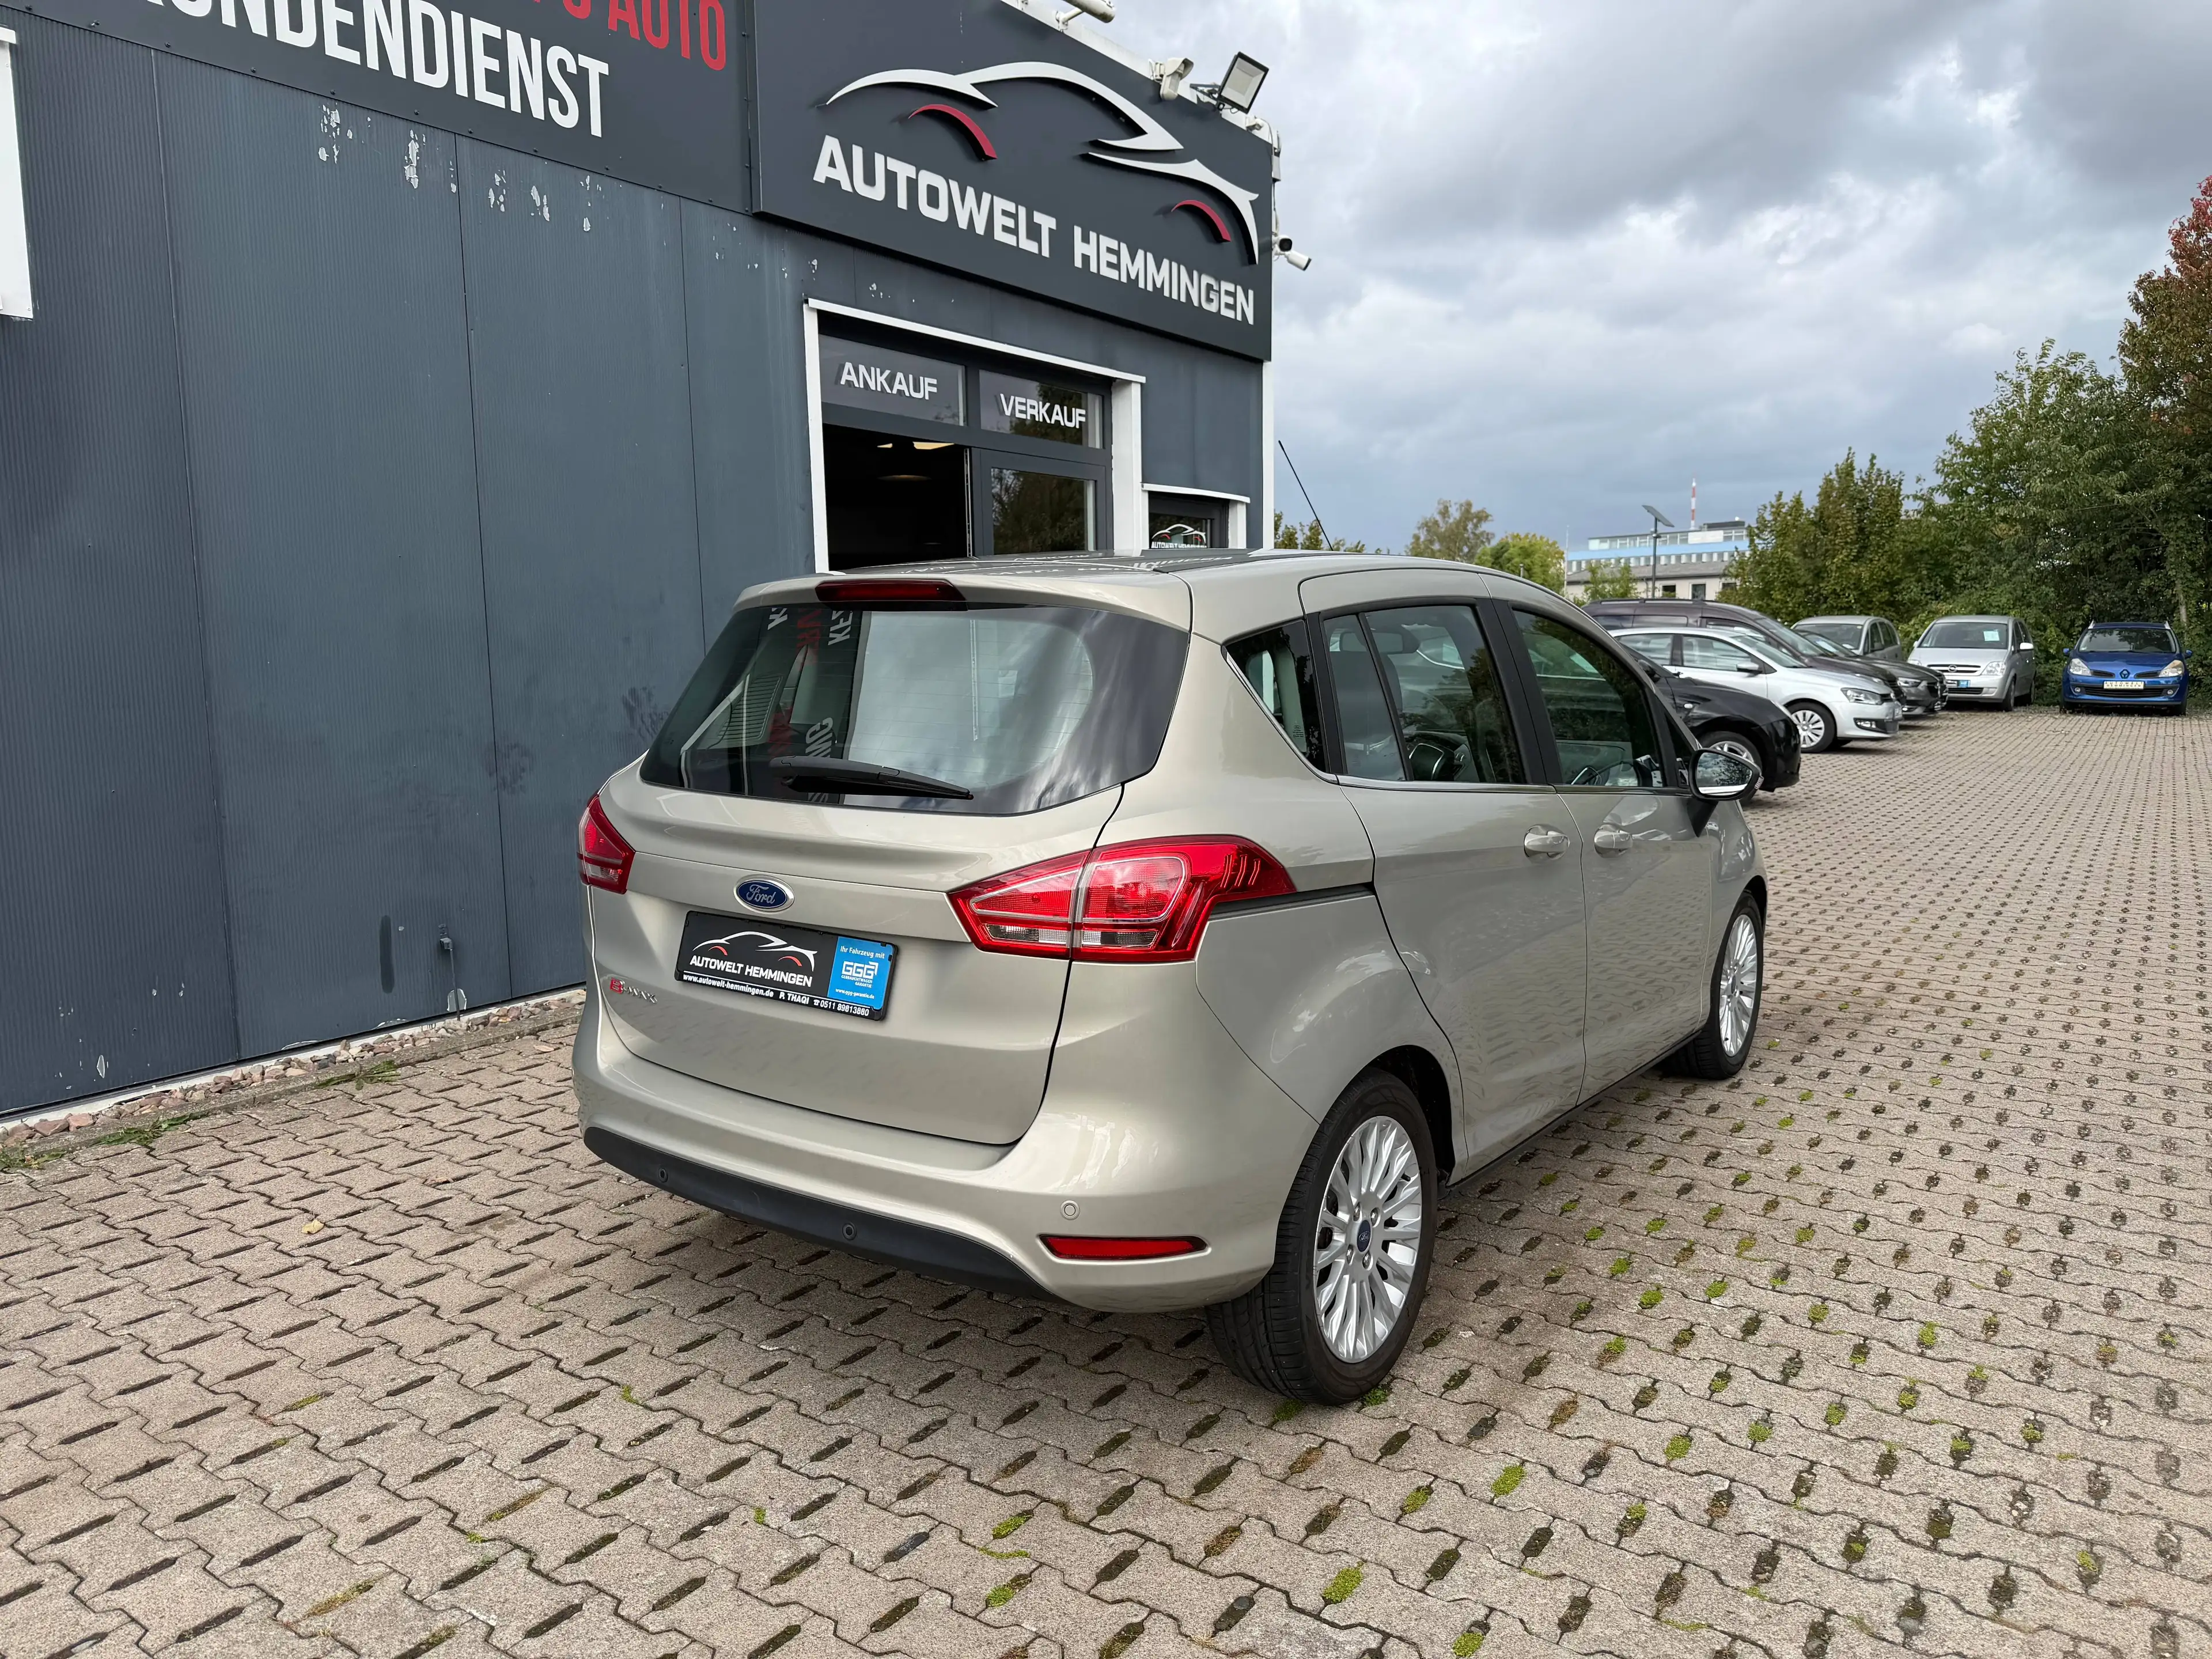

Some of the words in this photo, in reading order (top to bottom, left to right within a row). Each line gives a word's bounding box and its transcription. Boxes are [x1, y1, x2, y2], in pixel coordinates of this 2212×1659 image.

[146, 0, 609, 138] DENDIENST
[813, 134, 1056, 259] AUTOWELT
[1073, 225, 1255, 325] HEMMINGEN
[840, 362, 938, 400] ANKAUF
[999, 393, 1086, 429] VERKAUF
[746, 884, 777, 904] Ford
[849, 948, 874, 959] Fahrzeug
[689, 955, 744, 974] AUTOWELT
[744, 964, 813, 987] HEMMINGEN
[840, 975, 873, 984] GEBRAUCHTWAGEN
[841, 961, 877, 979] GGG
[683, 974, 774, 998] www.autowelt-hemmingen.de
[787, 993, 809, 1005] THAQI
[820, 1001, 836, 1010] 0511
[836, 1003, 870, 1016] 89813880
[835, 988, 875, 999] www.ggg-garantie.de
